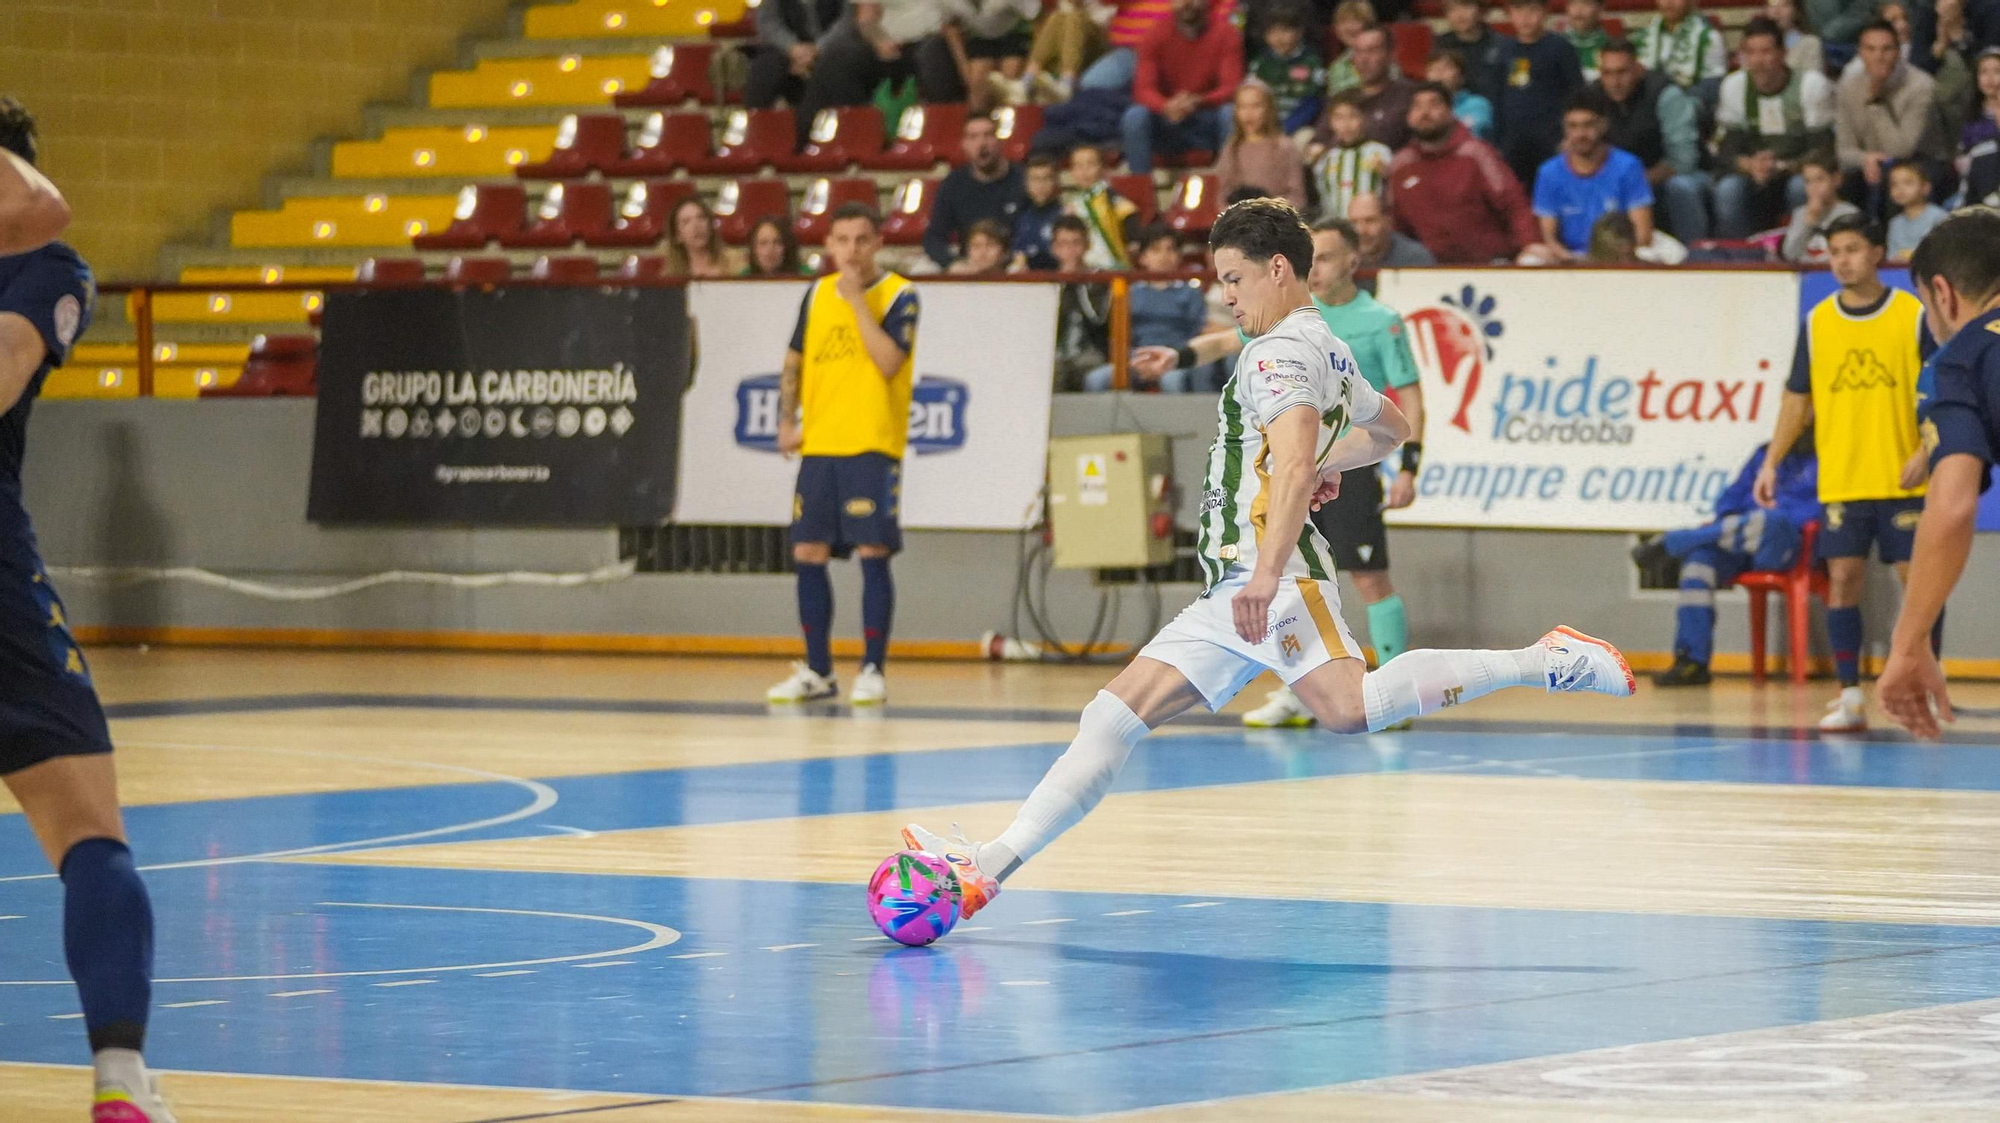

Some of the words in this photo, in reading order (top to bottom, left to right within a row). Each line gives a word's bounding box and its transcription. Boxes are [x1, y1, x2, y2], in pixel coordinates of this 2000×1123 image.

[361, 371, 441, 404] GRUPO
[446, 371, 477, 403] LA
[480, 362, 637, 403] CARBONERÍA
[1492, 356, 1770, 438] pidetaxi
[1380, 449, 1564, 511] empre
[1580, 456, 1728, 514] contig
